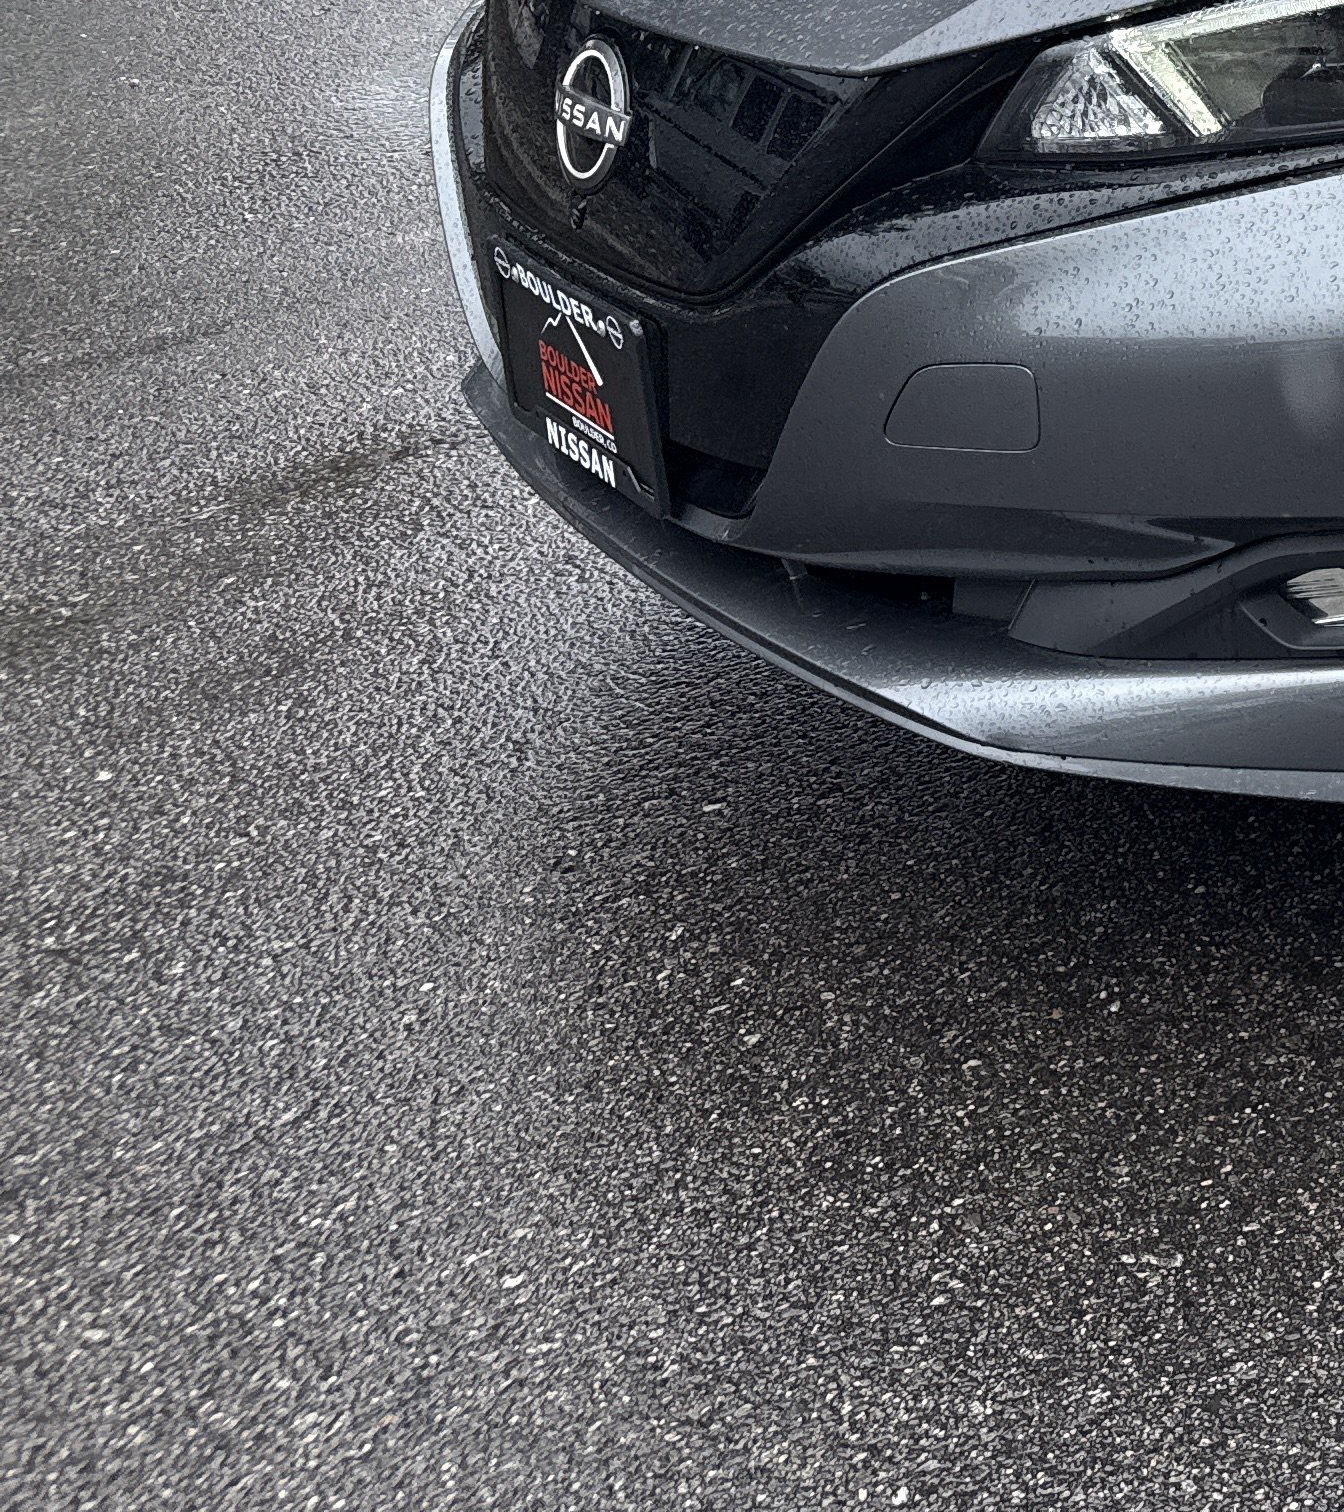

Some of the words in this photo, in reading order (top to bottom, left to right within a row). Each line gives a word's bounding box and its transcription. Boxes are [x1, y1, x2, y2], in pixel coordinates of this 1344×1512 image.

[516, 262, 598, 331] BOULDER
[539, 339, 597, 394] BOULDER
[541, 361, 614, 434] NISSAN
[545, 417, 616, 488] NISSAN
